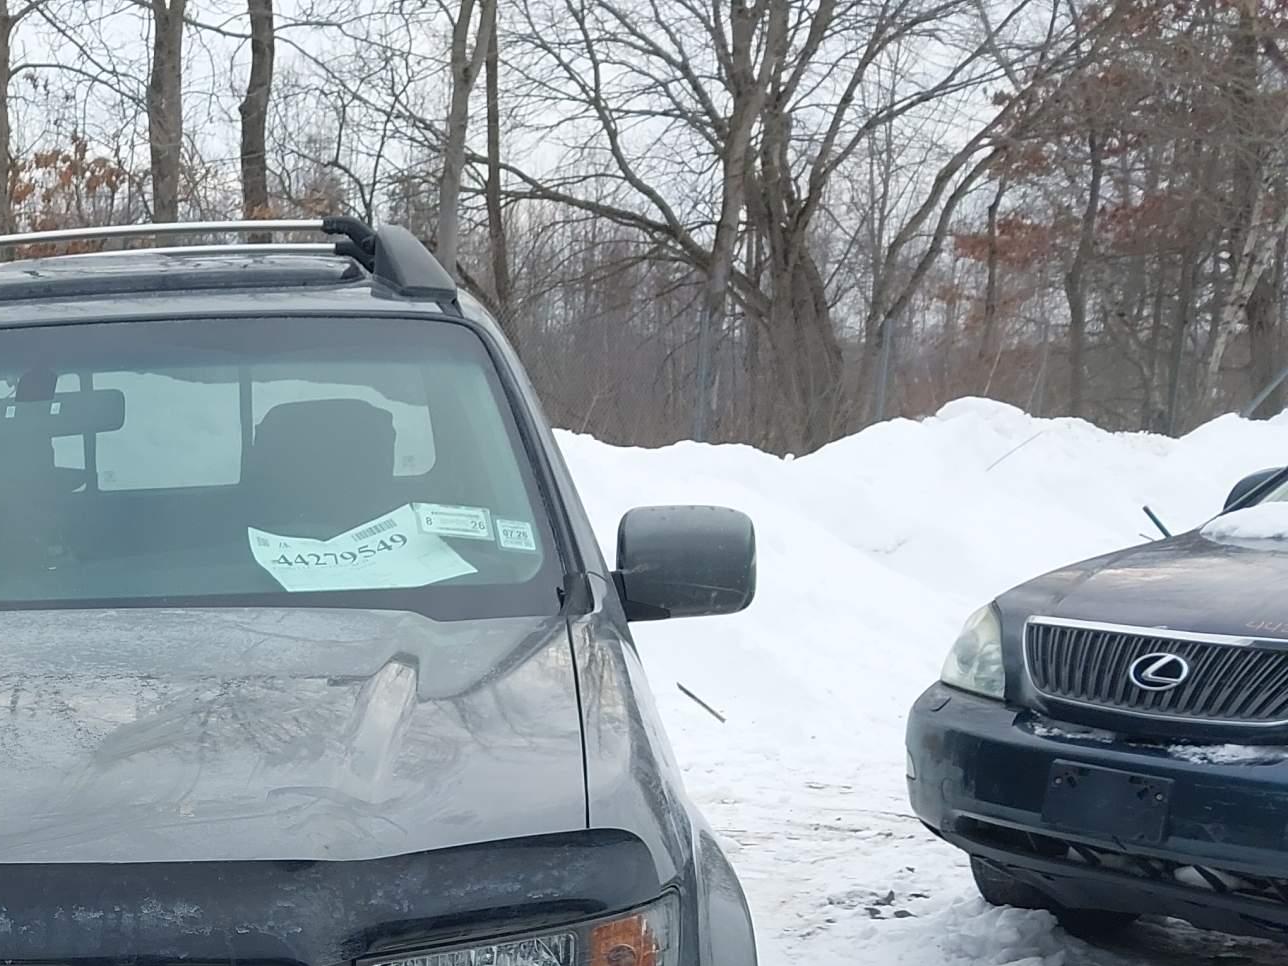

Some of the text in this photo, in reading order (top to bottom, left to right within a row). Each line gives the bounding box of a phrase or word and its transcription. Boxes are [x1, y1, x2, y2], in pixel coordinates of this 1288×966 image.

[425, 516, 433, 526] 8
[471, 520, 486, 530] 26
[272, 533, 408, 567] 44279549
